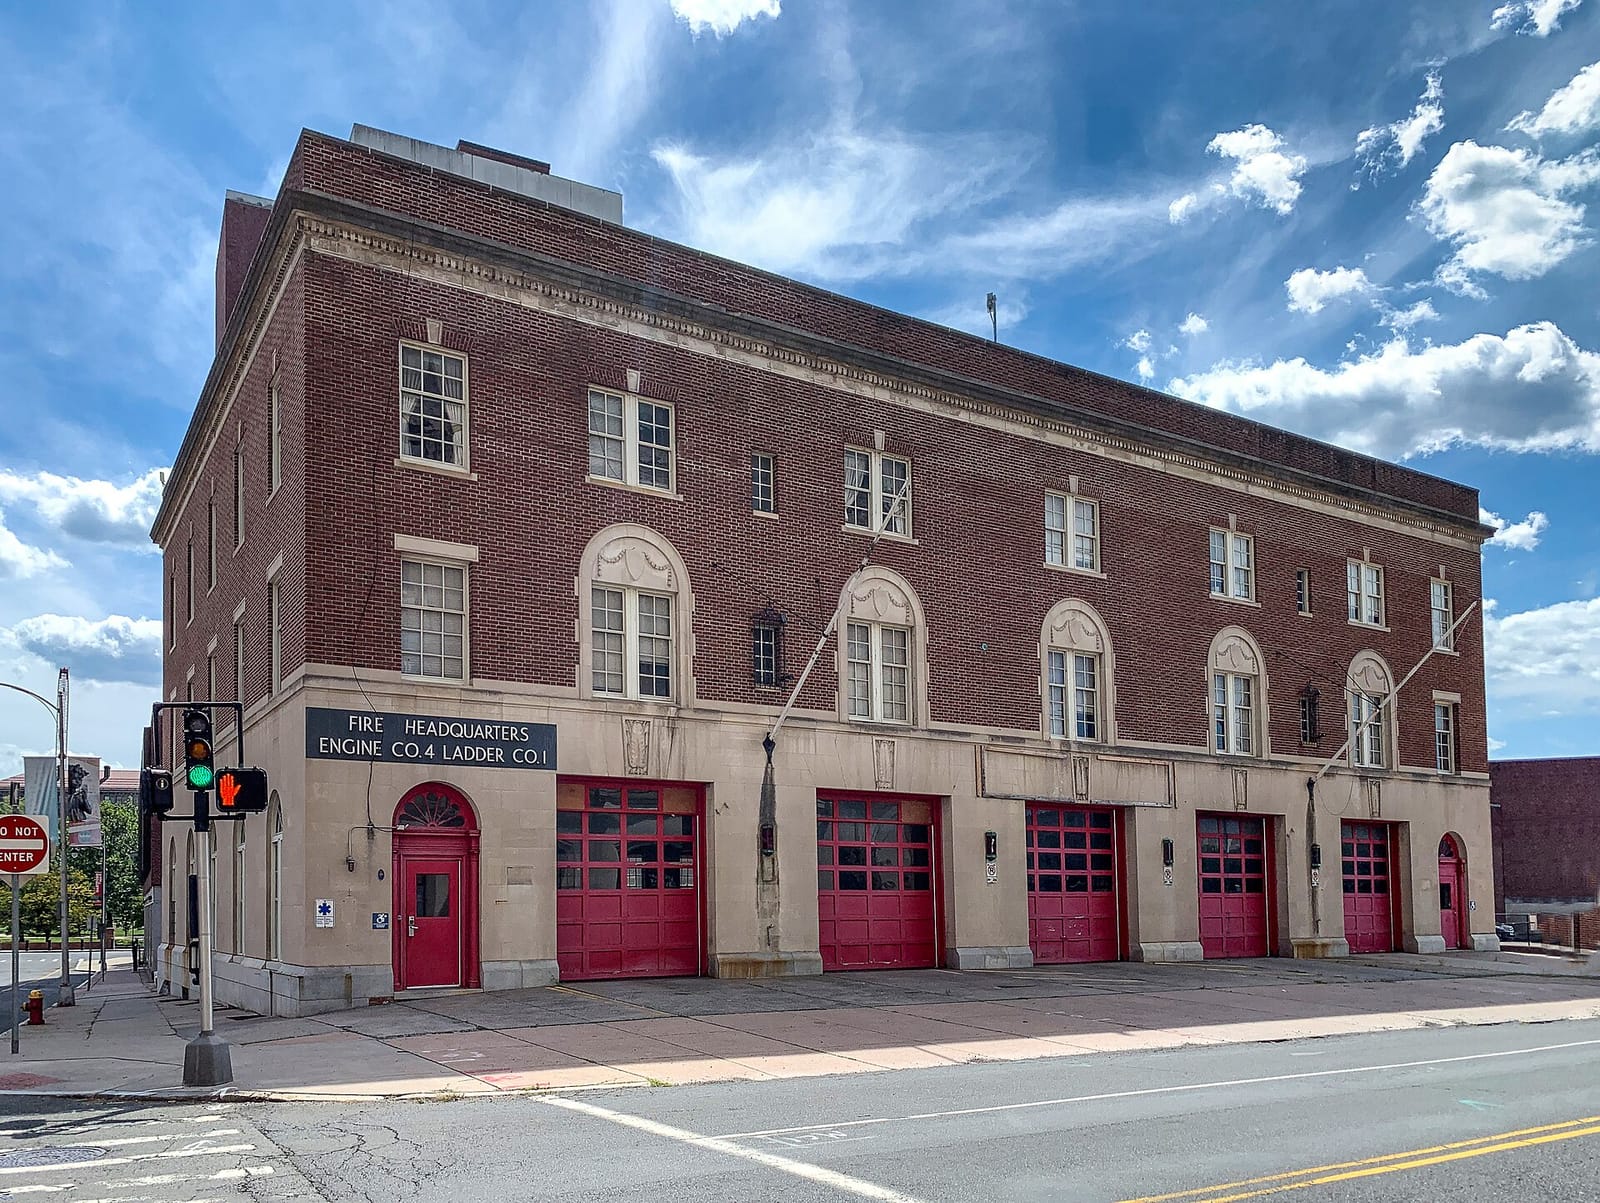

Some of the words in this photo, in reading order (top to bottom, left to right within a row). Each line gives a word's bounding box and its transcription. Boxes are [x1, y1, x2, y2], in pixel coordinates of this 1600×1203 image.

[348, 715, 384, 733] FIRE
[404, 718, 529, 742] HEADQUARTERS
[319, 737, 382, 756] ENGINE
[442, 744, 505, 763] LADDER
[0, 826, 8, 836] O
[15, 827, 38, 836] NOT
